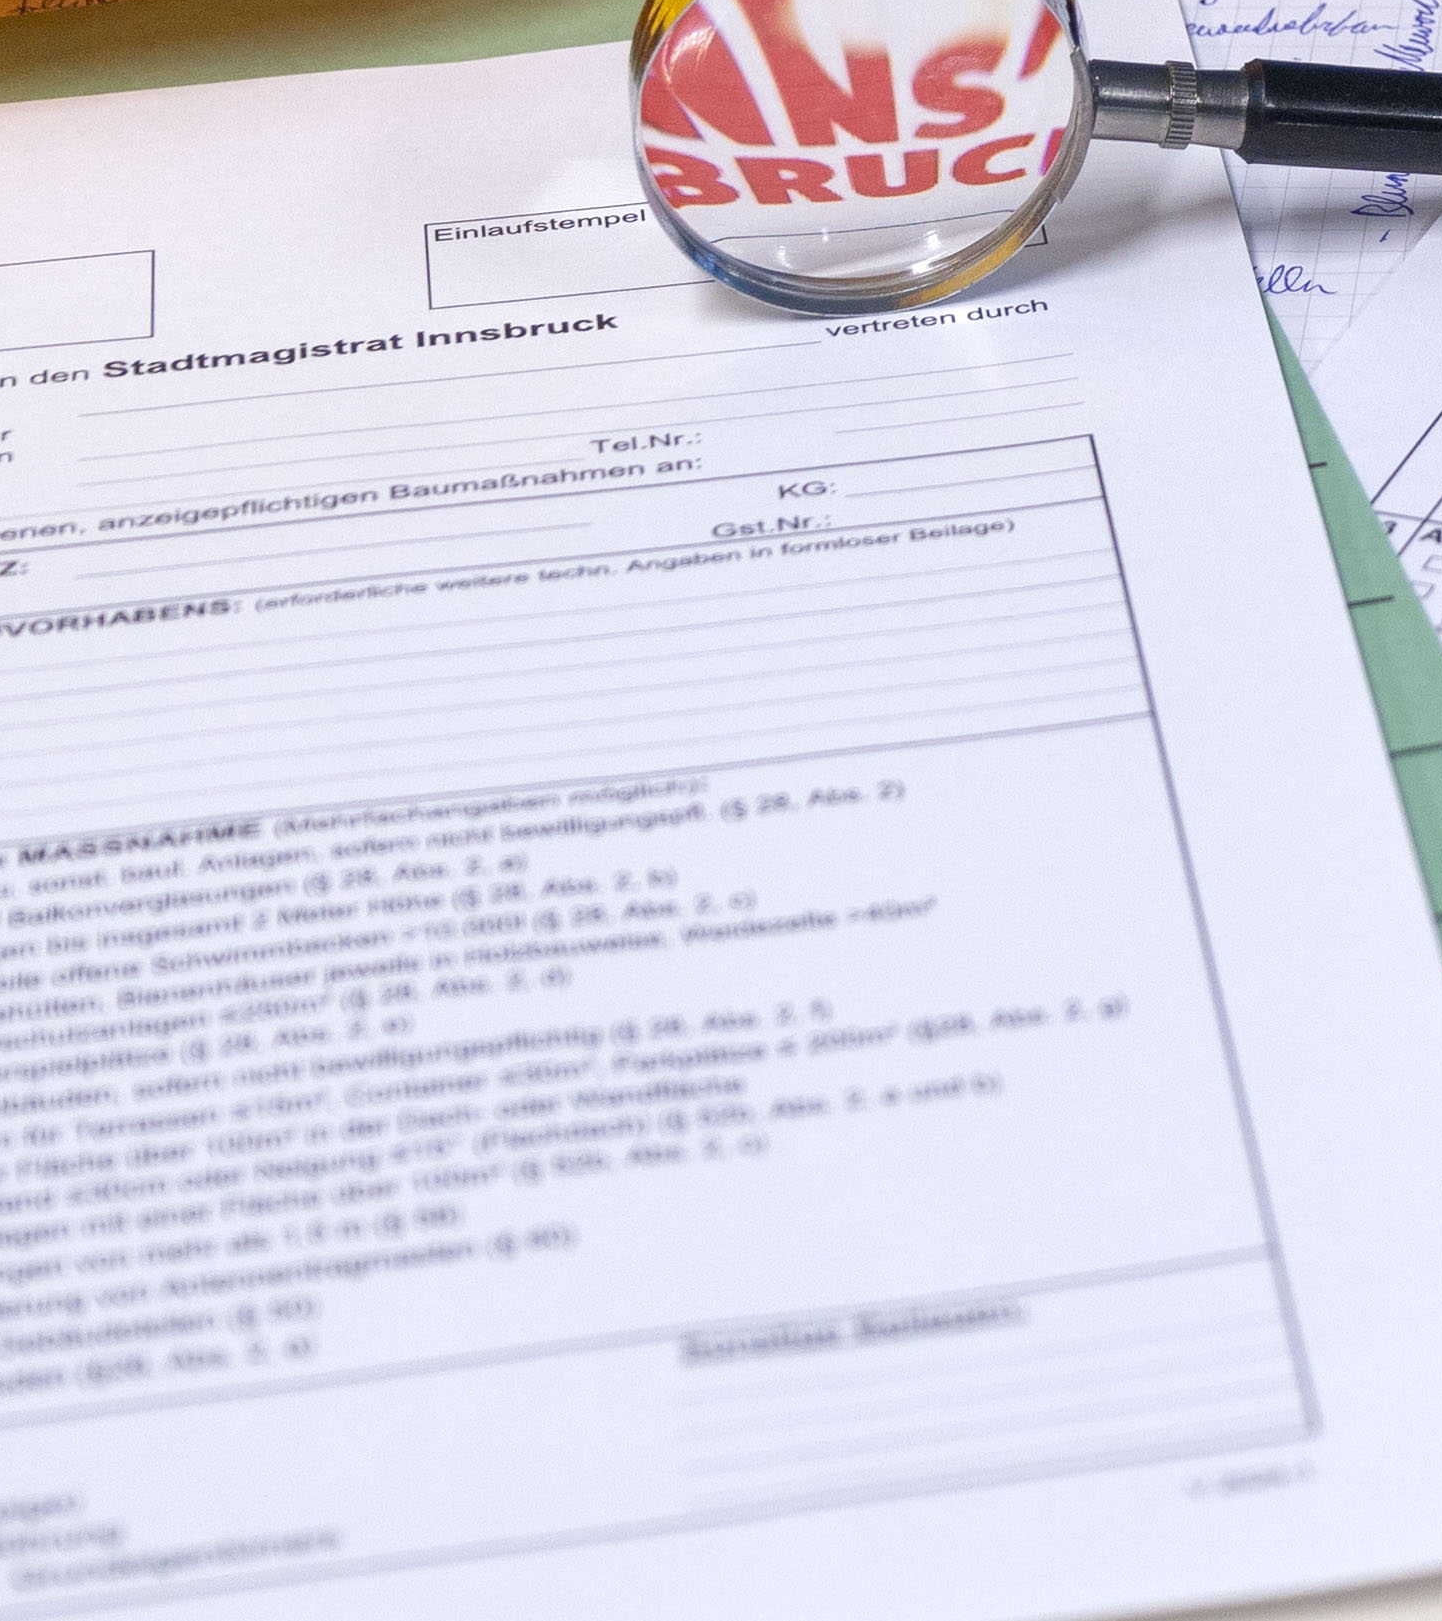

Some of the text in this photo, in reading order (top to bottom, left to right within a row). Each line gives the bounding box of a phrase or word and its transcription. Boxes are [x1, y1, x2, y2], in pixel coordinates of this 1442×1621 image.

[434, 208, 645, 241] Einlaufstempel
[825, 299, 1048, 336] vertreten durch
[29, 369, 89, 384] den
[103, 334, 403, 378] Stadtmagistrat
[416, 313, 617, 347] Innsbruck
[98, 490, 378, 531] anzeigepflichtigen
[389, 463, 645, 500] Baumaßnahmen
[656, 457, 701, 473] an:
[777, 480, 835, 499] KG:
